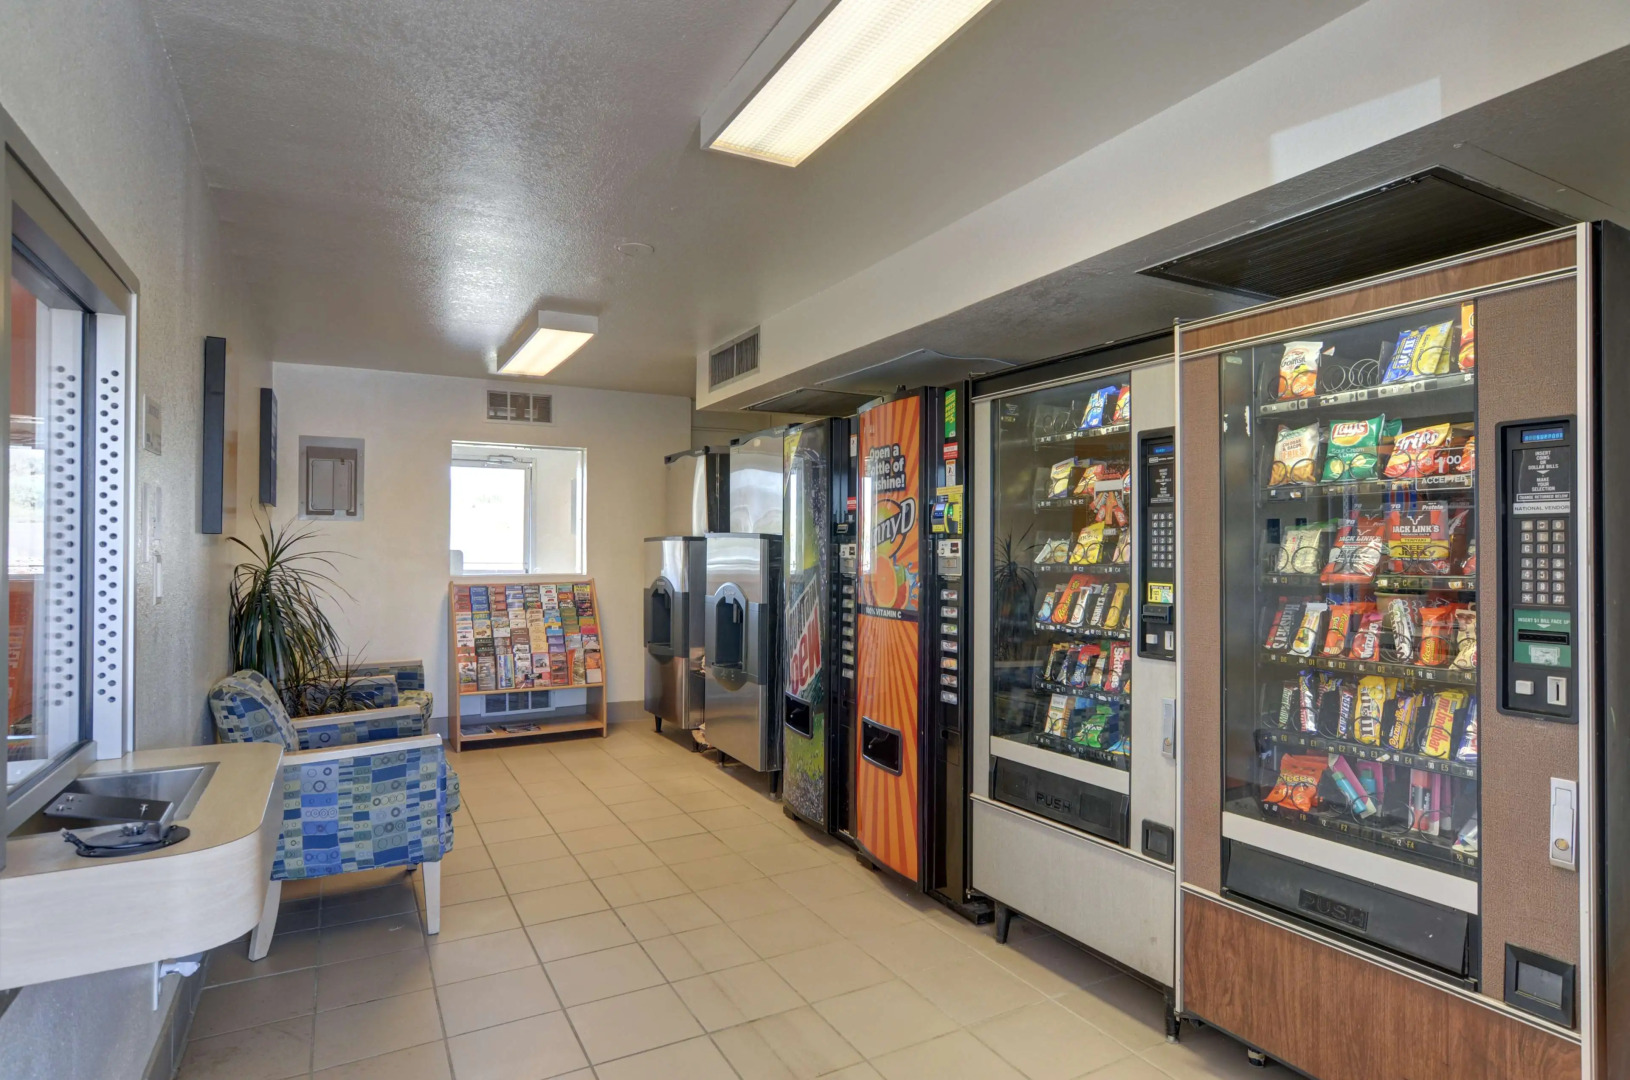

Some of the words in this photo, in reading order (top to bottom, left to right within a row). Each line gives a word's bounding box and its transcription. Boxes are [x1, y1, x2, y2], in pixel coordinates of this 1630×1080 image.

[869, 446, 890, 462] Open
[893, 445, 899, 456] a
[893, 457, 905, 473] of
[1421, 475, 1468, 484] ACCEPTED
[1412, 524, 1440, 533] LINK'S
[875, 608, 897, 618] VITAMIN
[897, 610, 902, 618] C
[1035, 791, 1073, 813] PUSH
[1300, 892, 1366, 929] PUSH
